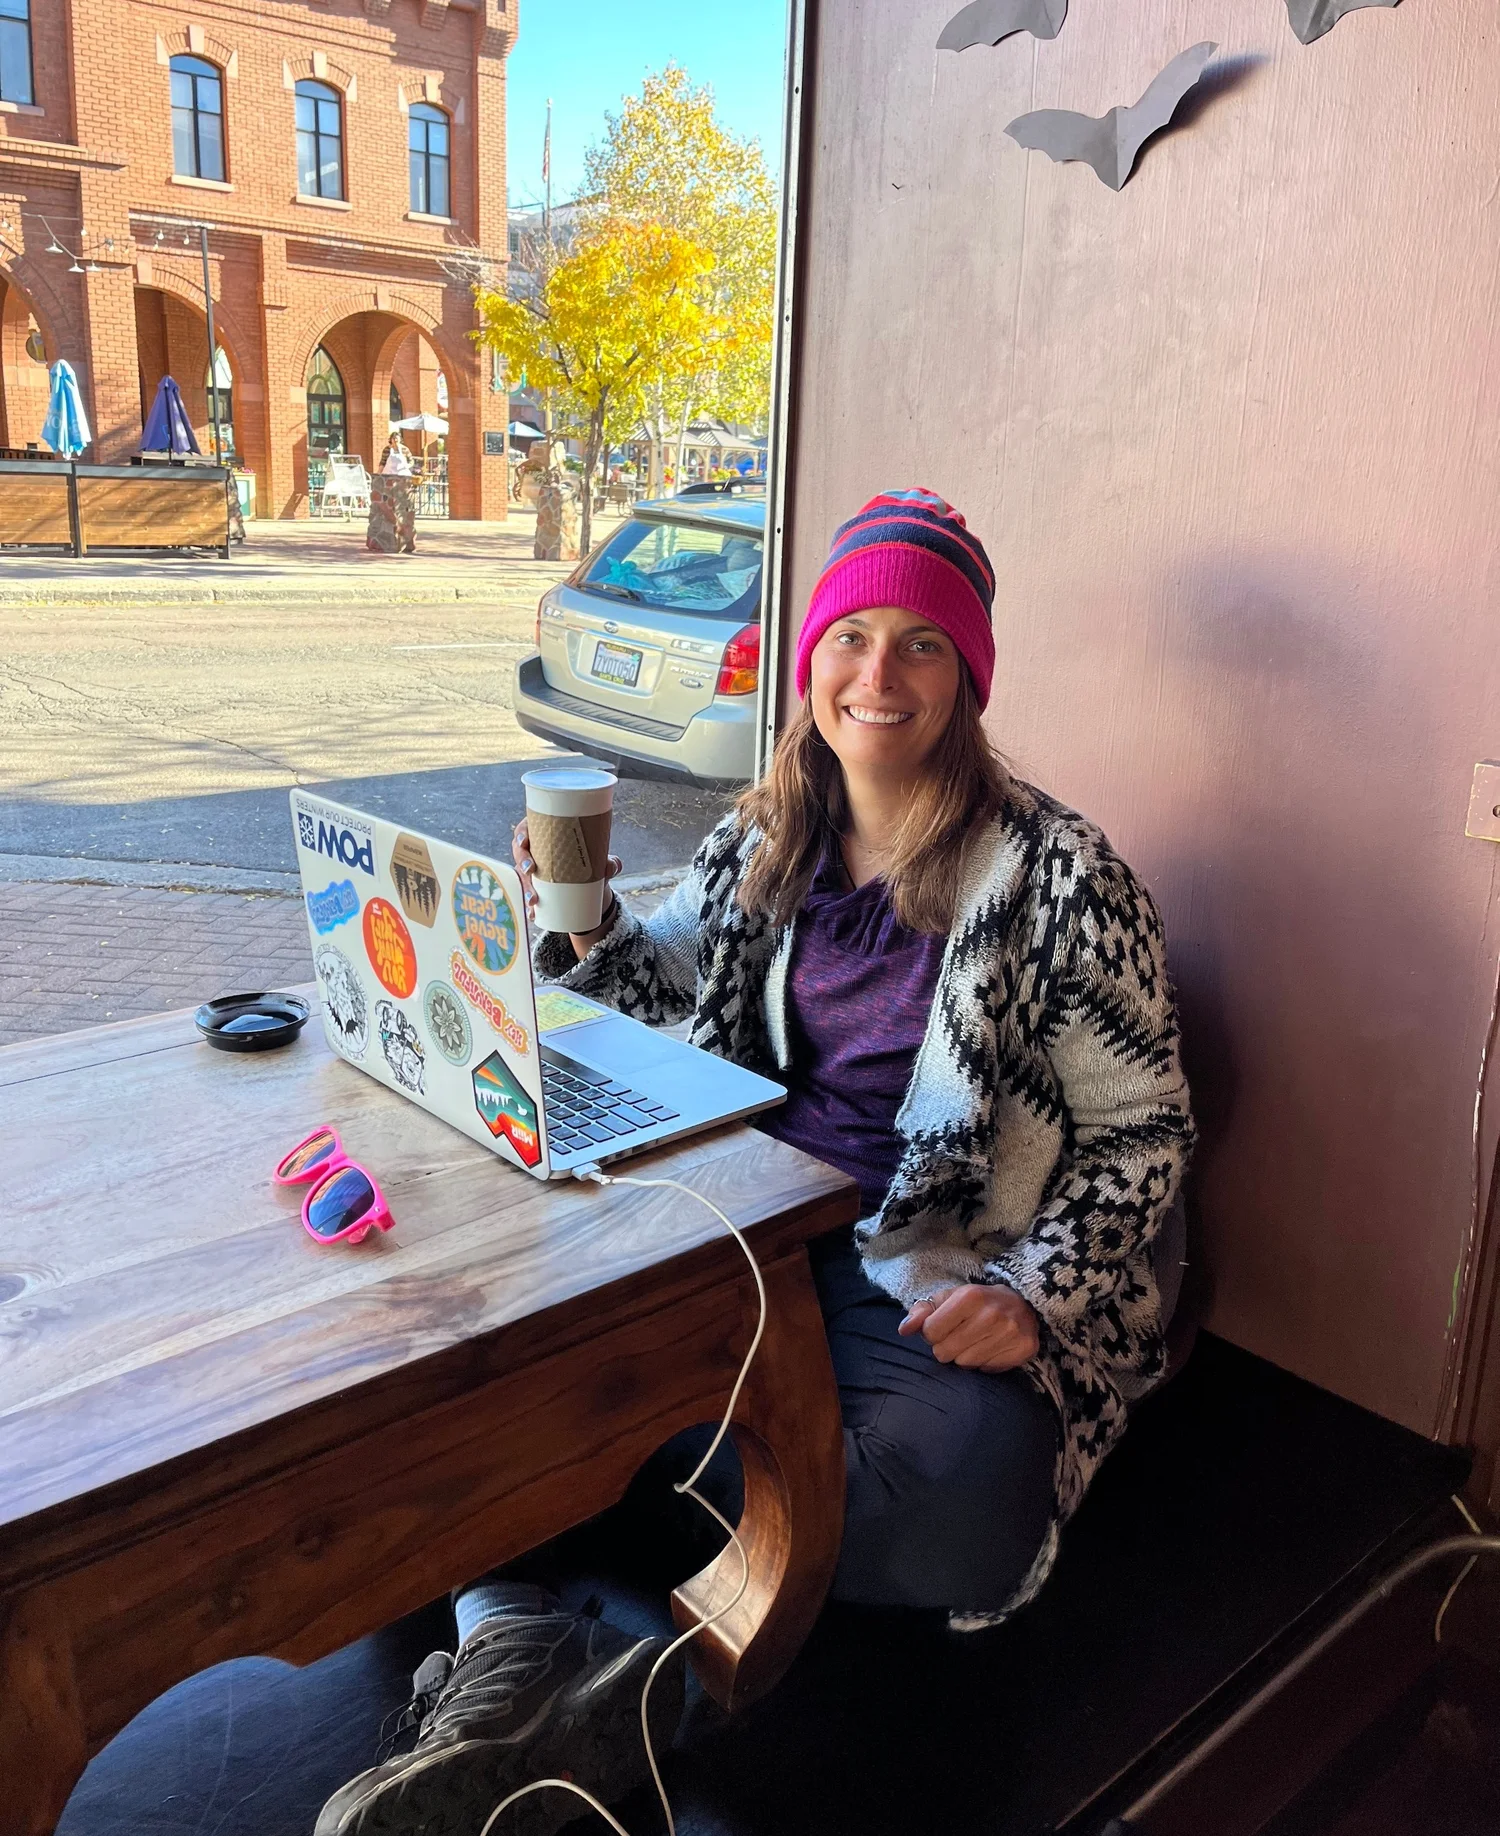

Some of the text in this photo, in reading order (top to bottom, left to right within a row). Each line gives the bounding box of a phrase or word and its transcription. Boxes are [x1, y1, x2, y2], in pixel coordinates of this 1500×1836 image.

[296, 798, 371, 835] PROTECT OUR WINTERS
[318, 820, 374, 876] POW
[460, 894, 497, 922] Gear
[464, 915, 509, 950] Revel
